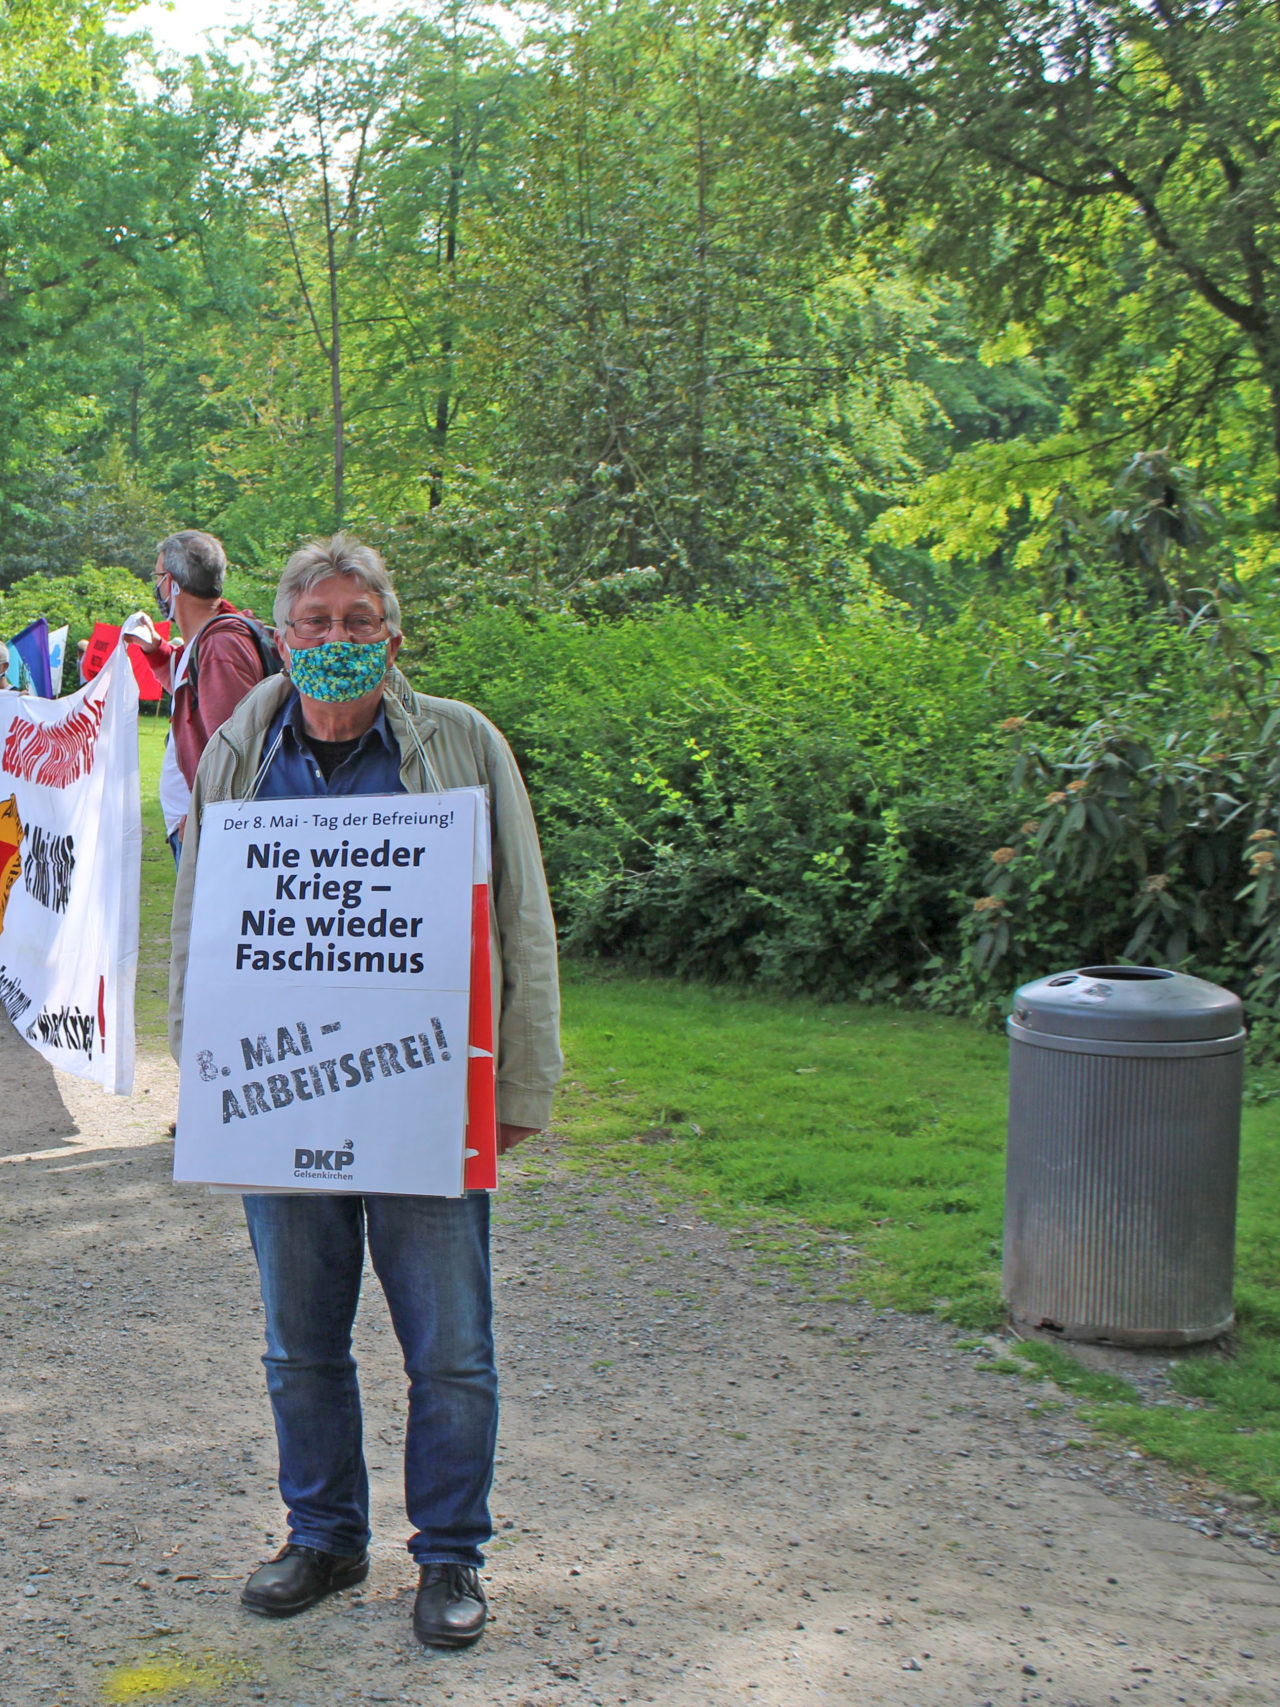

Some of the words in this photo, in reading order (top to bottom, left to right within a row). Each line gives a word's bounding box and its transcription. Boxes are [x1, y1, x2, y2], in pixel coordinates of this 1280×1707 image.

[223, 817, 250, 831] Der
[253, 816, 266, 829] 8.
[269, 814, 299, 828] Mai
[311, 814, 339, 832] Tag
[342, 812, 369, 827] der
[371, 810, 455, 830] Befreiung!
[246, 841, 301, 869] Nie
[310, 839, 426, 868] wieder
[275, 874, 363, 909] Krieg
[241, 909, 296, 937] Nie
[305, 908, 423, 938] wieder
[235, 942, 425, 975] Faschismus
[196, 1048, 232, 1083] 8.
[239, 1020, 313, 1071] MAI
[221, 1016, 453, 1125] ARBEITSFREI!
[293, 1147, 355, 1171] DKP
[293, 1168, 354, 1181] Gelsenkirchen
